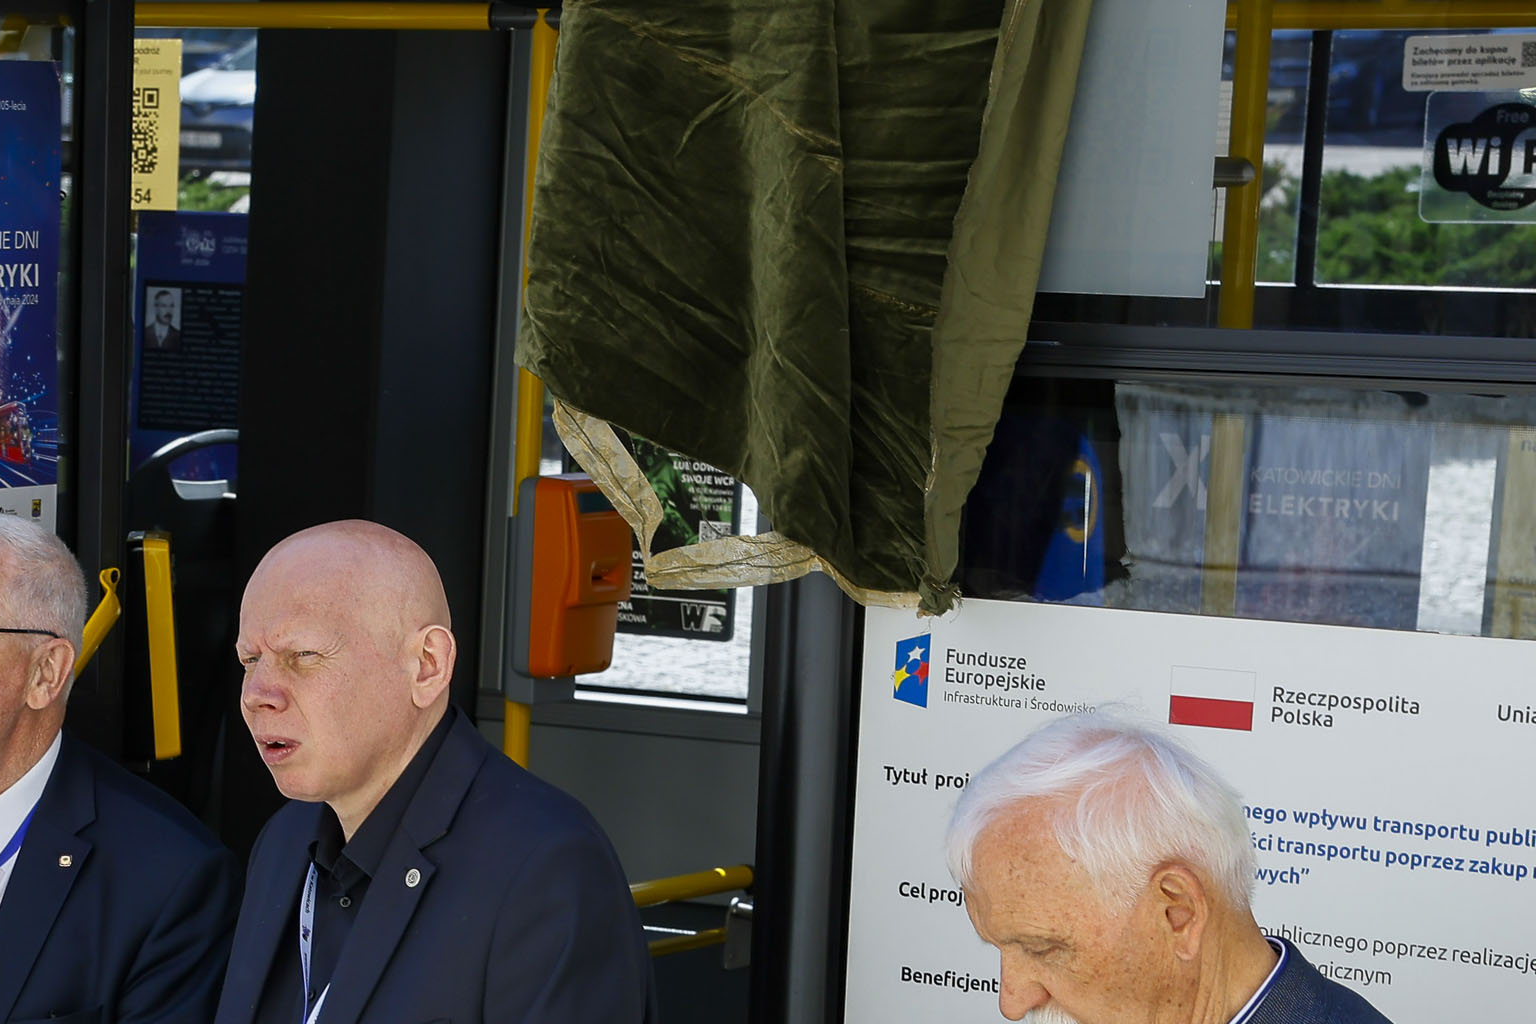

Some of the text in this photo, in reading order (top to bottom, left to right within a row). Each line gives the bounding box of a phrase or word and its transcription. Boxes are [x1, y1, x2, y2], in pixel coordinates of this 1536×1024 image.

[1466, 46, 1477, 54] do
[15, 230, 39, 249] DNI
[22, 294, 39, 305] 2024
[1251, 467, 1362, 488] KATOWICKIE
[1368, 471, 1402, 489] DNI
[1249, 493, 1401, 521] ELEKTRYKI
[946, 648, 1027, 670] Fundusze
[945, 667, 1047, 691] Europejskie
[943, 691, 1022, 709] Infrastruktura
[1030, 698, 1097, 715] Środowisko
[1272, 686, 1421, 715] Rzeczpospolita
[1271, 706, 1334, 728] Polska
[883, 765, 928, 786] Tytuł
[1293, 808, 1368, 831] wpływu
[1373, 816, 1480, 842] transportu
[1277, 836, 1381, 863] transportu
[1384, 849, 1464, 872] poprzez
[1468, 857, 1528, 882] zakup
[898, 881, 926, 900] Cel
[1372, 938, 1447, 962] poprzez
[900, 966, 999, 994] Beneficjent
[1313, 961, 1393, 986] gicznym
